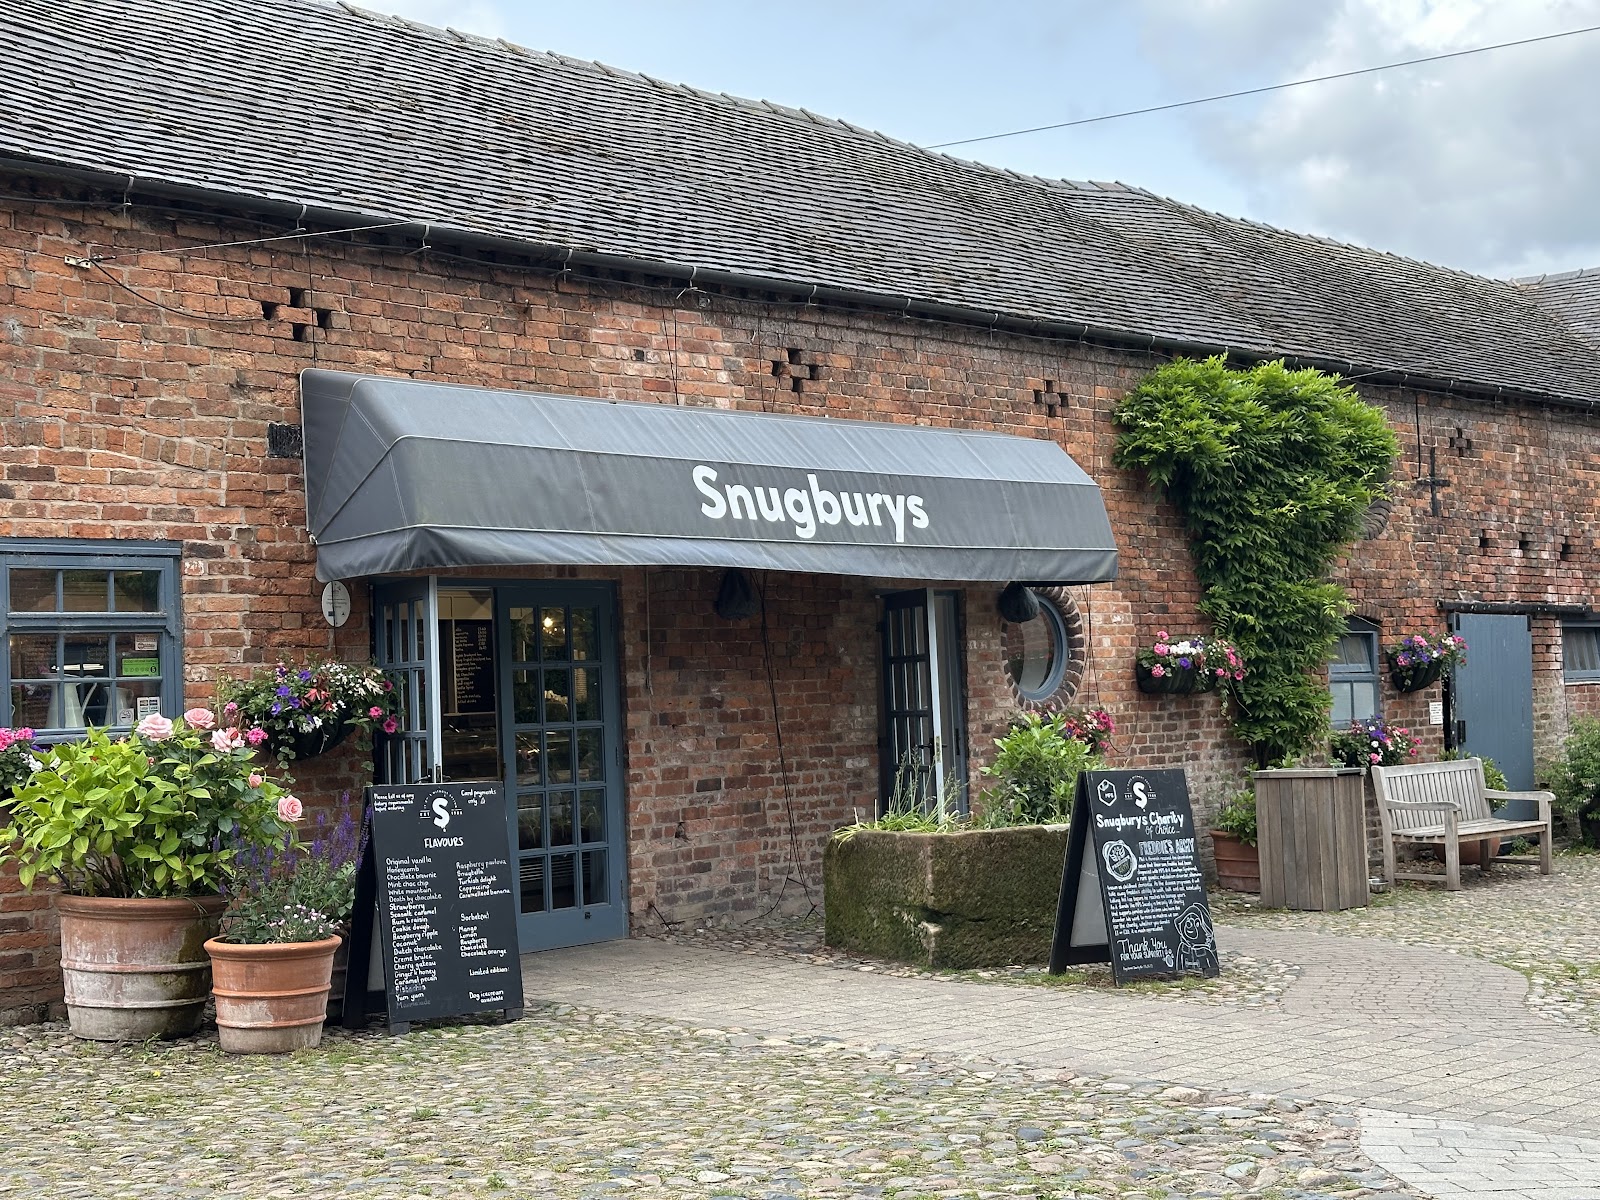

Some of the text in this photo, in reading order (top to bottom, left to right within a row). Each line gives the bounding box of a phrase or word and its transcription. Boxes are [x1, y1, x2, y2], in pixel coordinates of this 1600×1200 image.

[692, 464, 929, 543] Snugburys
[474, 788, 497, 798] payments
[1149, 811, 1184, 828] Charity
[424, 837, 464, 848] FLAVOURS
[386, 856, 432, 868] Original vanilla
[456, 861, 484, 870] Raspberry
[386, 865, 420, 875] Honeycomb
[387, 872, 415, 880] Chocolate
[458, 875, 497, 885] Turkish delight
[417, 880, 429, 888] chip
[459, 884, 490, 893] Cappuccino
[407, 896, 413, 904] by
[414, 893, 442, 901] chocolate
[389, 902, 425, 911] Strawberry
[414, 907, 437, 916] caramel
[413, 923, 430, 933] dough
[392, 929, 438, 941] Raspberry ripple
[392, 939, 418, 947] Coconut
[460, 943, 487, 951] Chocolate
[1117, 937, 1167, 954] Thank You
[394, 943, 442, 955] Dutch chocolate
[461, 949, 507, 957] Chocolate orange
[1120, 952, 1130, 961] FOR
[1130, 951, 1142, 960] YOUR
[394, 960, 436, 971] Cherry gateau
[395, 971, 413, 980] Ginger
[418, 969, 436, 977] honey
[469, 967, 489, 976] Limited
[395, 976, 438, 985] Caramel pecan
[410, 993, 424, 1001] yum
[469, 992, 480, 1001] Dog
